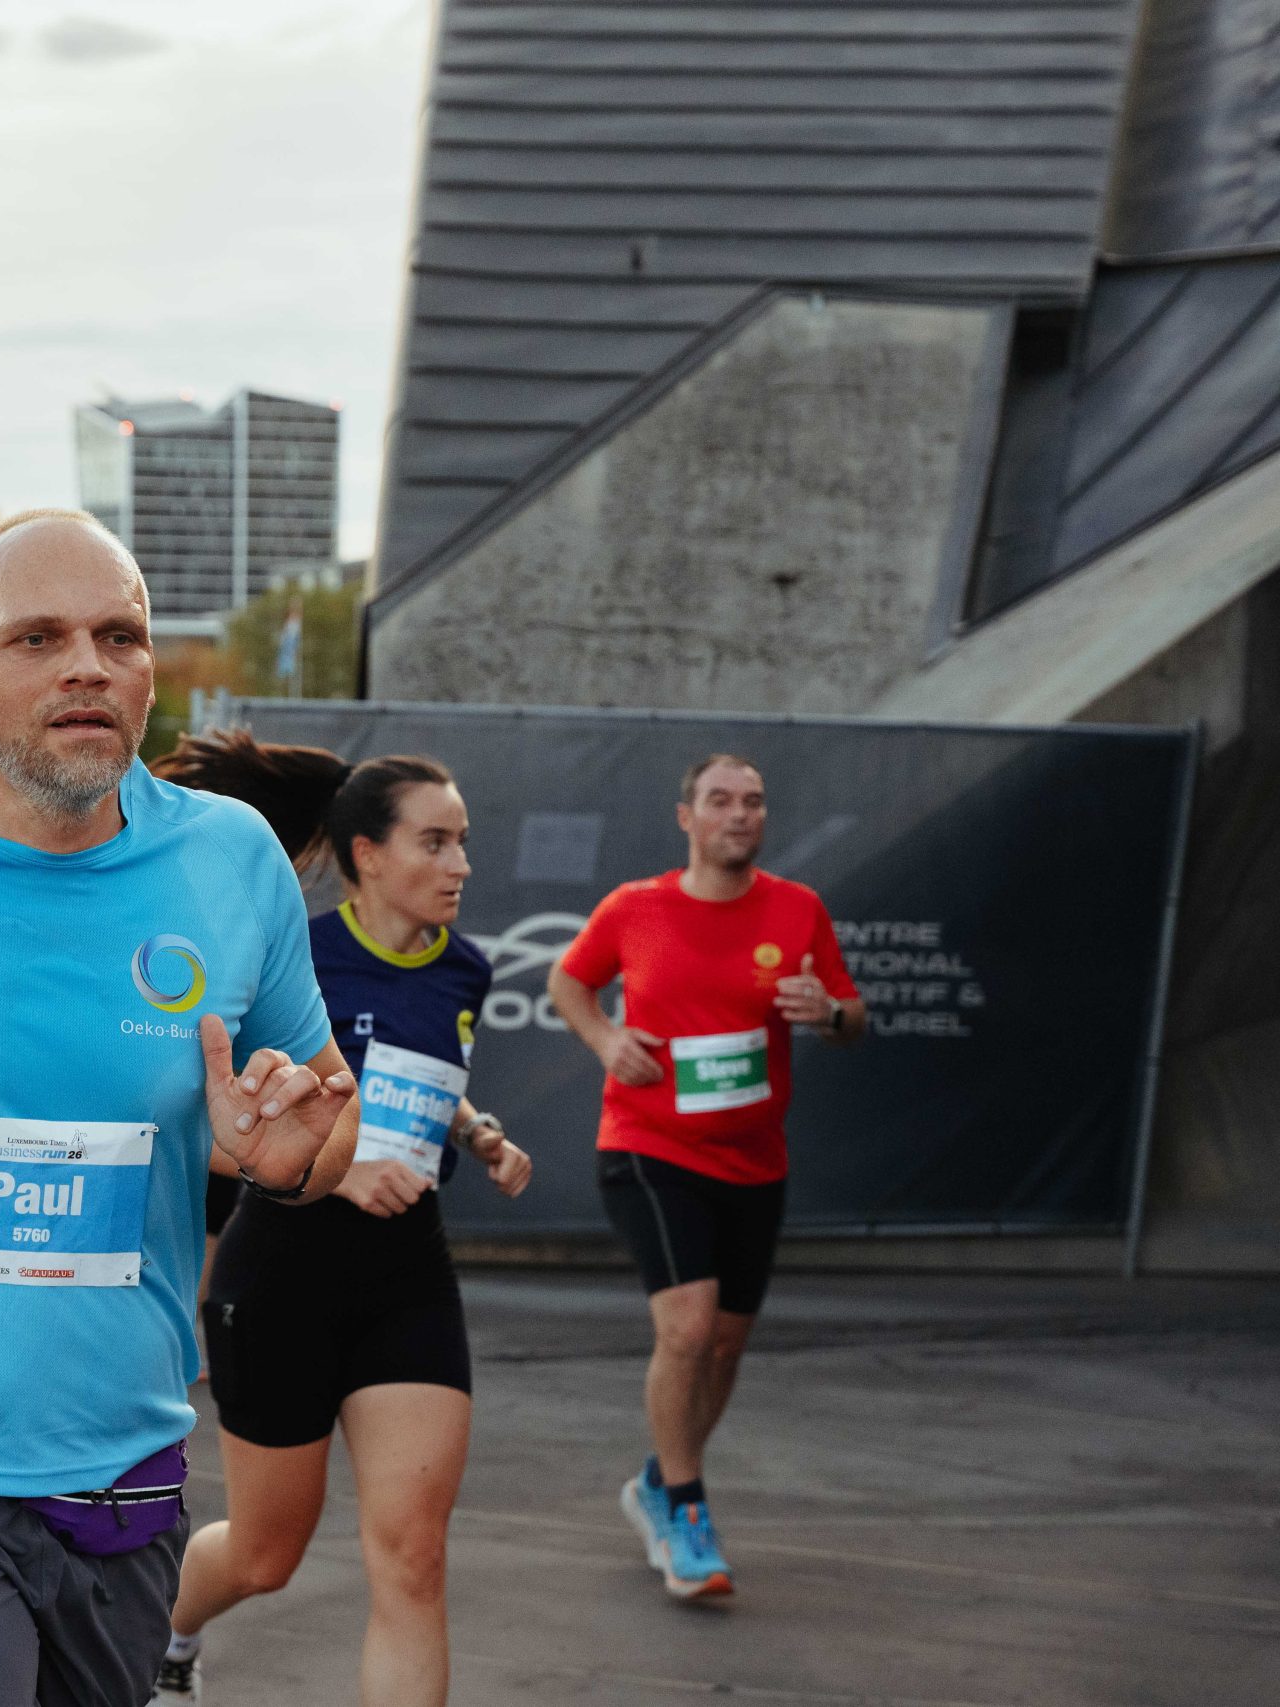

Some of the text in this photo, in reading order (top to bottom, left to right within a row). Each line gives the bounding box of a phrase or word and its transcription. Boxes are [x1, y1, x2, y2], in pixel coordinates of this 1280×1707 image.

[120, 1019, 201, 1040] Oeko-Bure
[67, 1150, 83, 1159] 26
[12, 1227, 51, 1243] 5760
[26, 1269, 75, 1278] BAUHAUS
